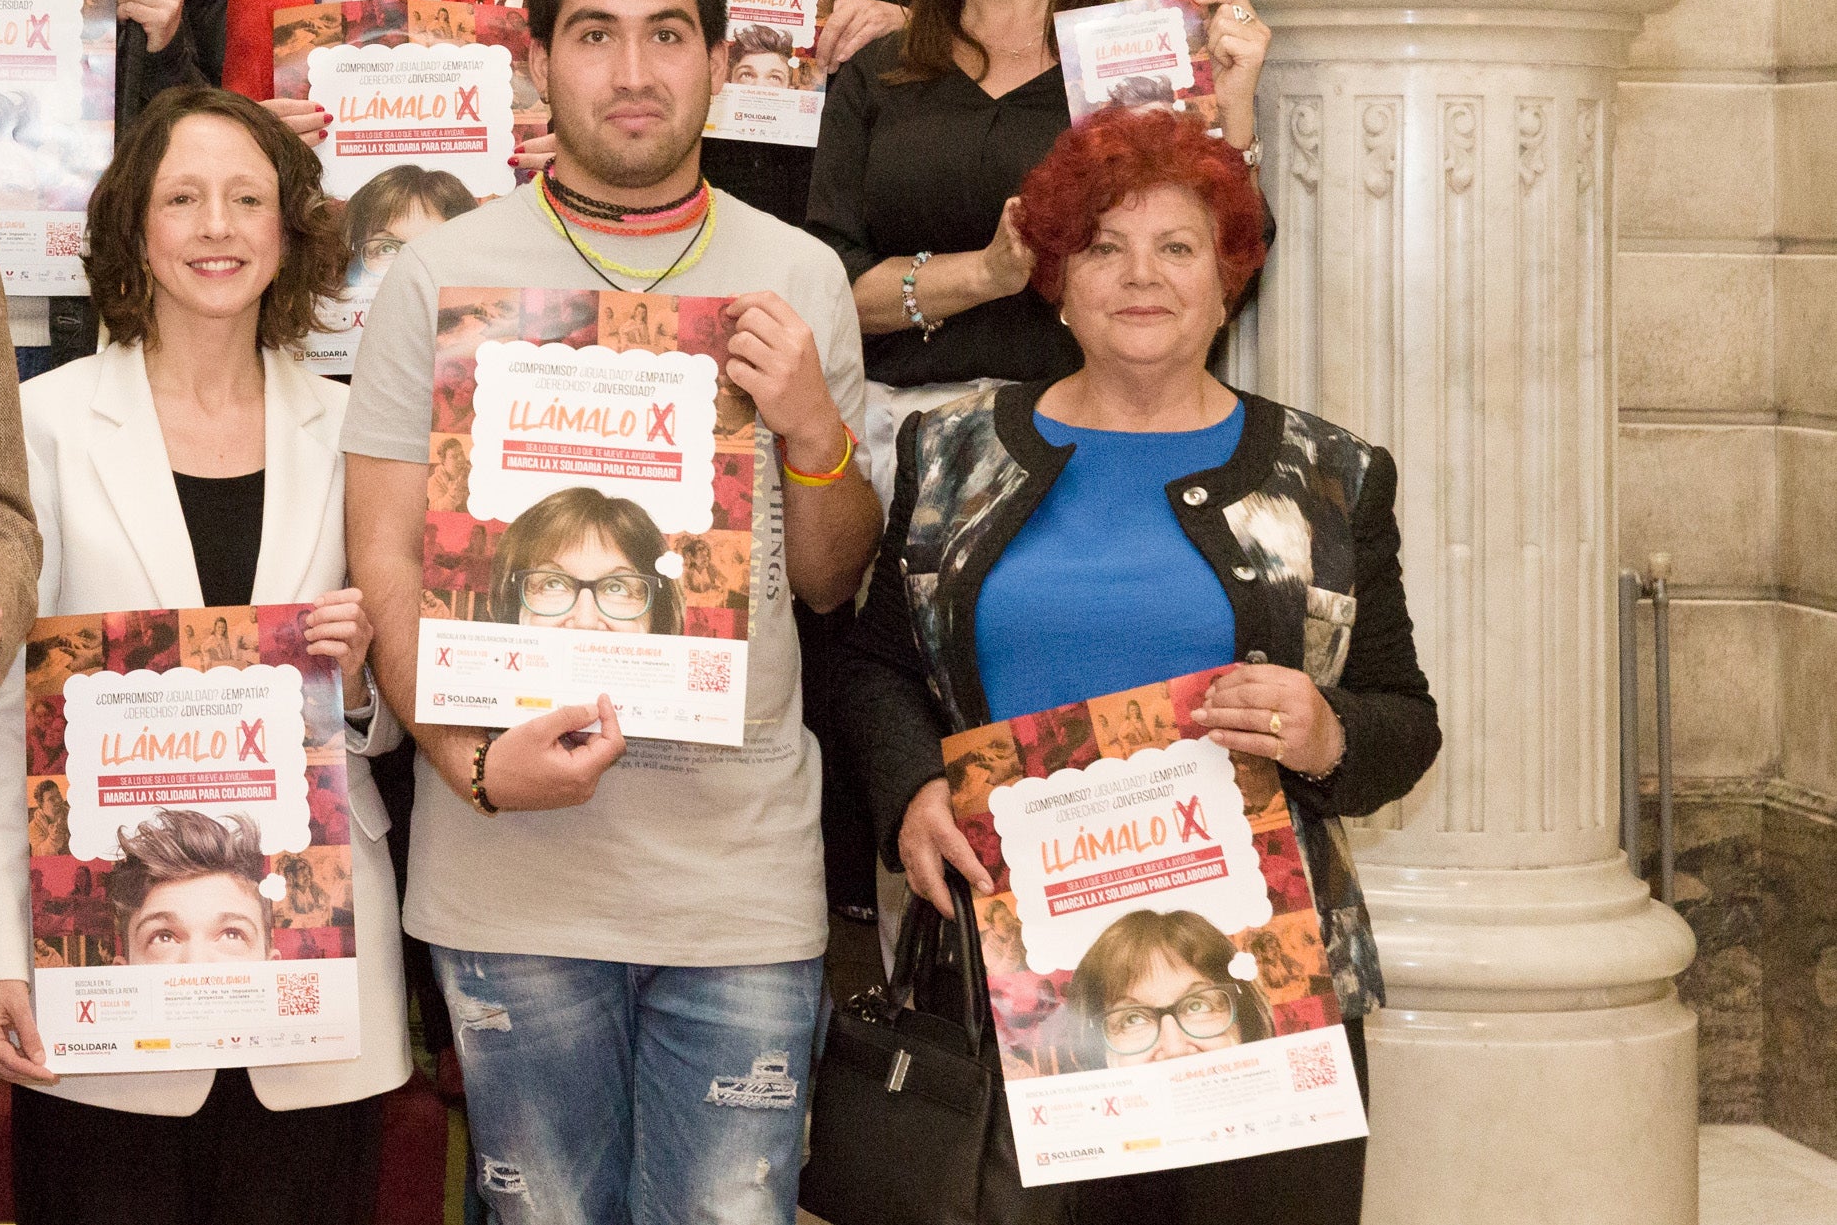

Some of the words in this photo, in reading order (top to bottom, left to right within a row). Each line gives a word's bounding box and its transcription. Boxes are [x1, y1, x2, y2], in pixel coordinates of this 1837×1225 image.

[336, 62, 394, 74] ¿COMPROMISO?
[442, 60, 484, 72] ¿EMPATÍA?
[408, 73, 461, 84] ¿DIVERSIDAD?
[339, 90, 446, 123] LLÁMALO
[744, 113, 777, 121] SOLIDARIA
[306, 350, 348, 358] SOLIDARIA
[509, 362, 577, 377] ¿COMPROMISO?
[635, 370, 684, 385] ¿EMPATÍA?
[593, 382, 656, 397] ¿DIVERSIDAD?
[508, 397, 637, 437] LLÁMALO
[766, 484, 783, 601] THINGS
[96, 690, 164, 706] ¿COMPROMISO?
[220, 685, 270, 701] ¿EMPATÍA?
[446, 694, 498, 705] SOLIDARIA
[180, 702, 243, 717] ¿DIVERSIDAD?
[102, 726, 227, 766] LLÁMALO
[104, 791, 134, 805] ¡MARCA
[135, 791, 147, 803] LA
[147, 790, 154, 803] X
[155, 788, 197, 803] SOLIDARIA
[198, 788, 220, 801] PARA
[221, 785, 272, 801] COLABORAR!
[1023, 787, 1093, 815] ¿COMPROMISO?
[1147, 760, 1199, 785] ¿EMPATÍA?
[1110, 782, 1176, 810] ¿DIVERSIDAD?
[1041, 816, 1165, 875] LLÁMALO
[67, 1043, 118, 1052] SOLIDARIA
[1050, 1145, 1105, 1161] SOLIDARIA
